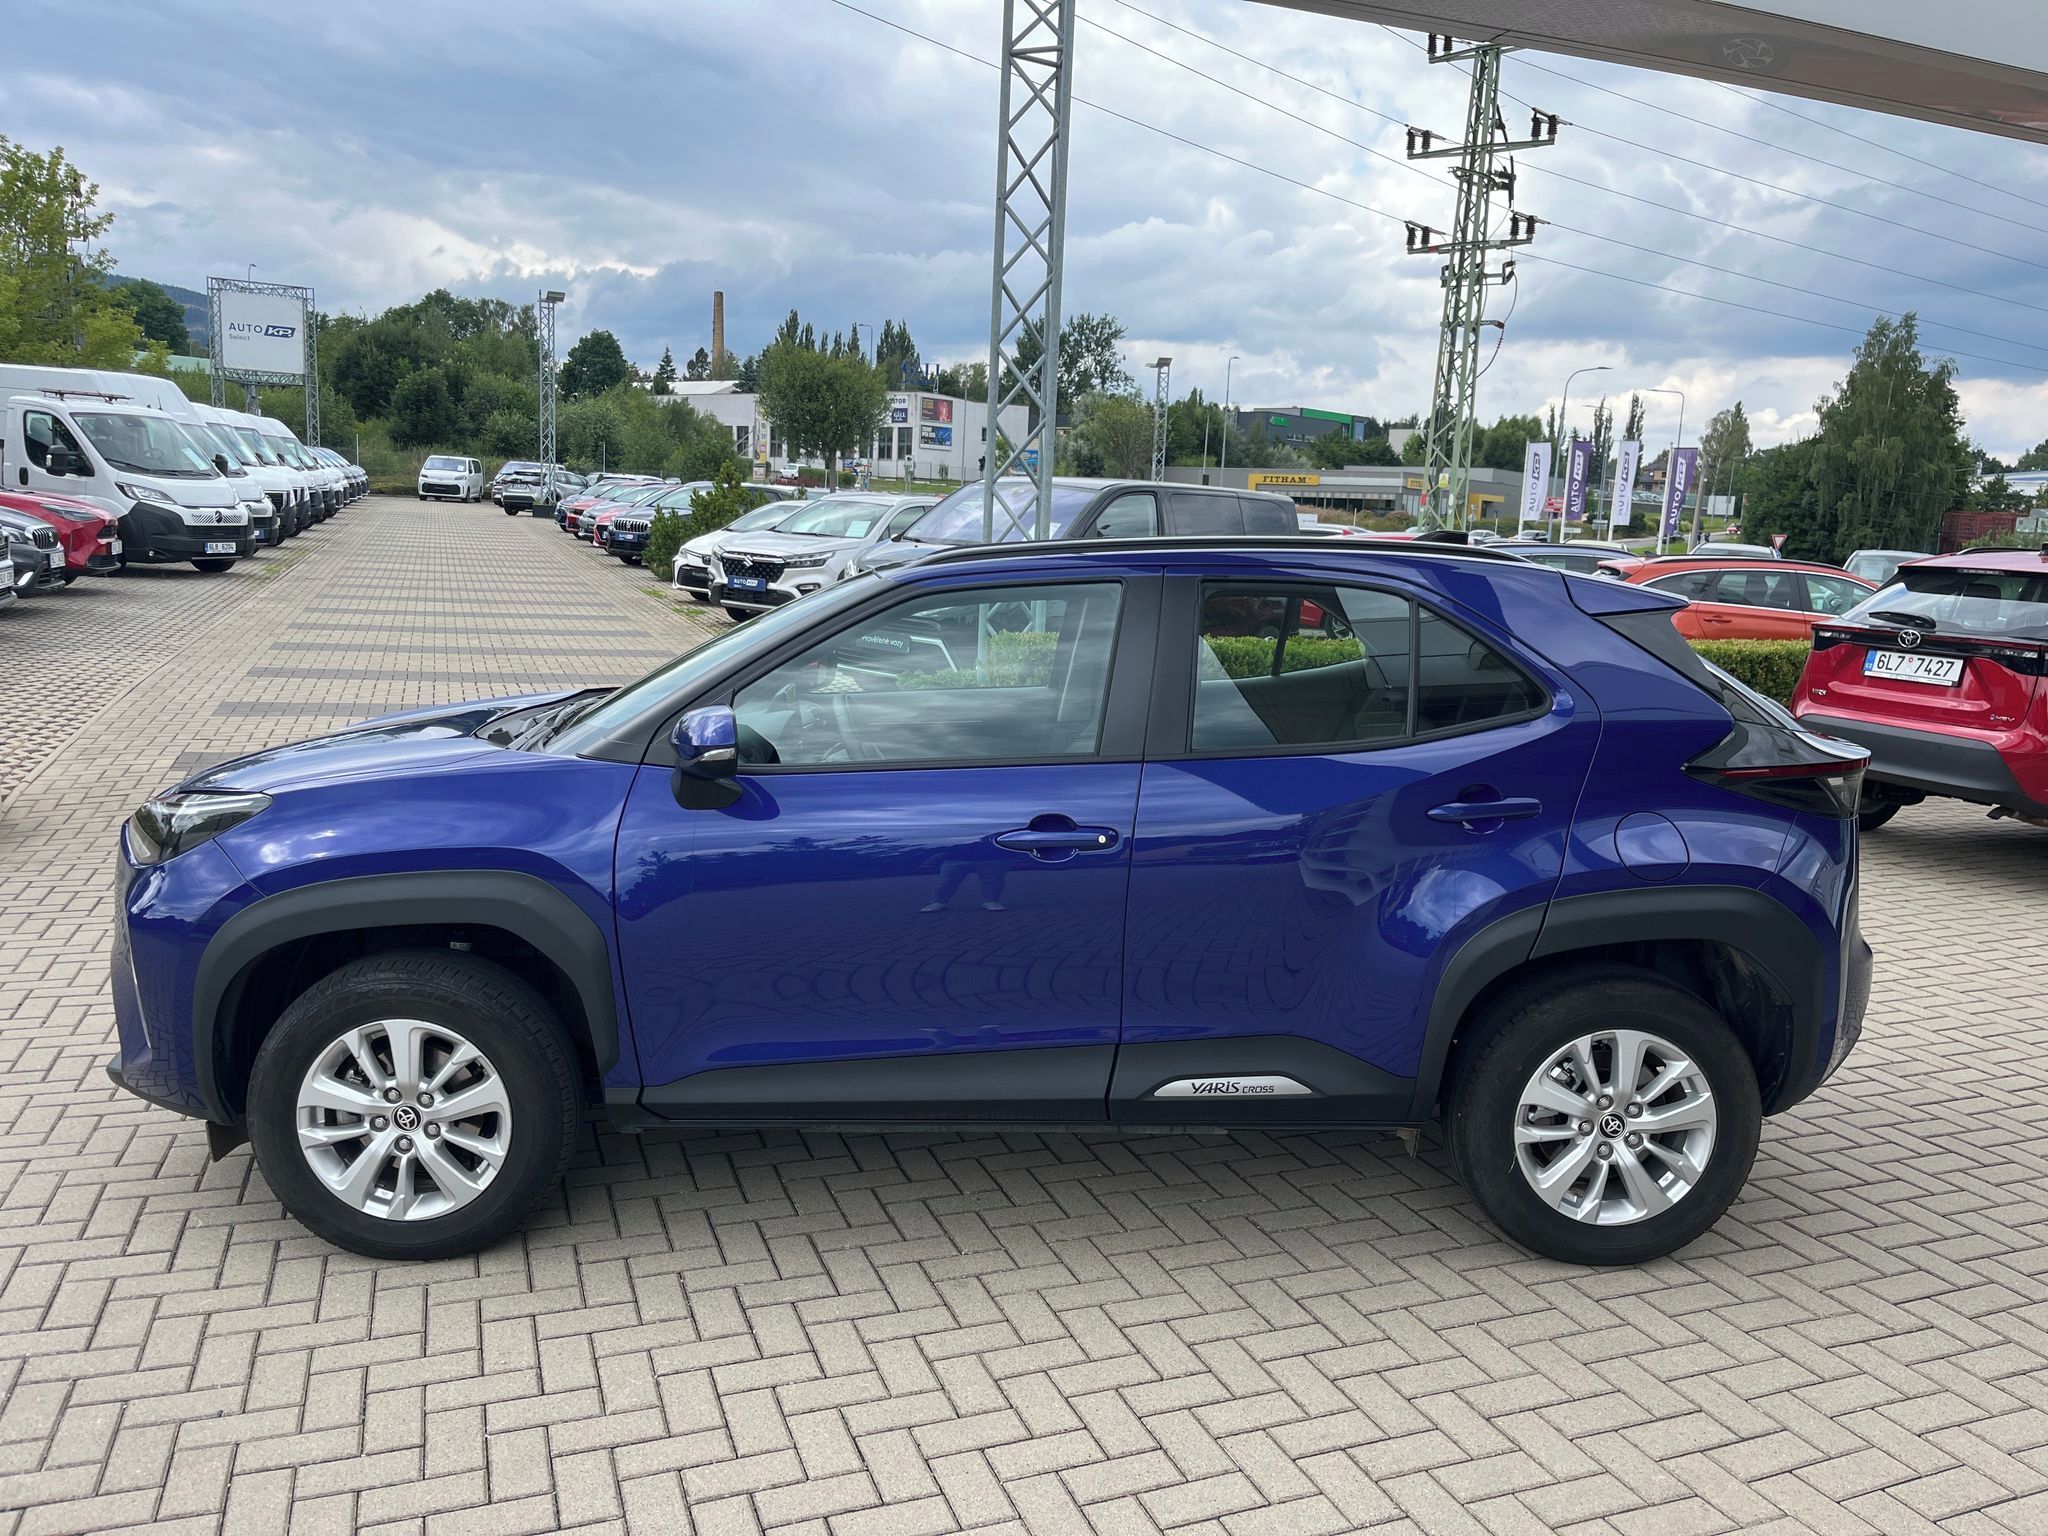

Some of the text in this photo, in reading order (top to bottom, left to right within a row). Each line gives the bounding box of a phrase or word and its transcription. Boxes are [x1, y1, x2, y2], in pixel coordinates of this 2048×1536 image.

[228, 322, 263, 334] AUTO
[1263, 475, 1307, 484] FITHAM
[1528, 482, 1538, 512] AUTO
[1571, 481, 1580, 513] AUTO
[1618, 483, 1626, 517] AUTO
[1669, 491, 1681, 525] AUTO
[890, 640, 904, 649] vozy
[1876, 653, 1955, 678] 6L7 7427
[1242, 1085, 1275, 1094] CROSS
